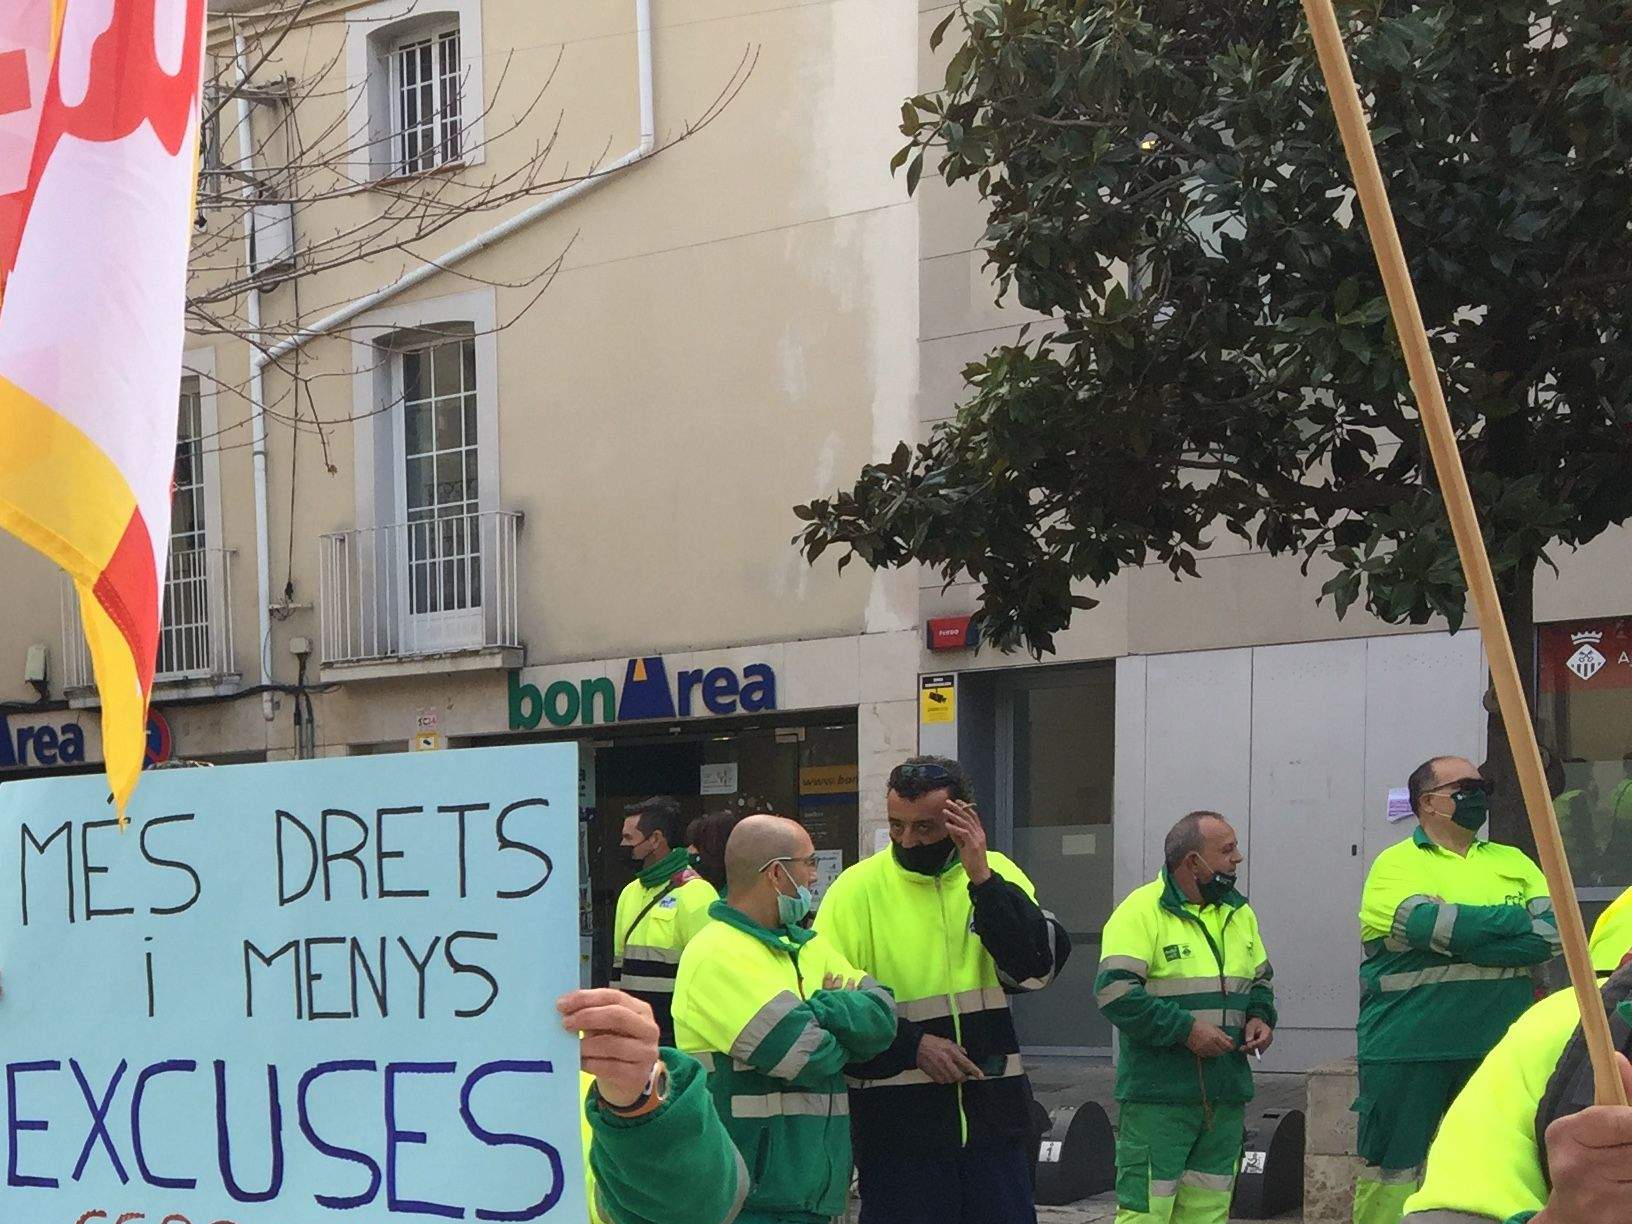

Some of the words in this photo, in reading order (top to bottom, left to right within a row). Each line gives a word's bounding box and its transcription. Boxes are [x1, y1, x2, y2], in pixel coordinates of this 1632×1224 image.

[275, 798, 554, 907] DRETS
[243, 930, 499, 1021] MENYS
[5, 1057, 566, 1223] EXCUSES
